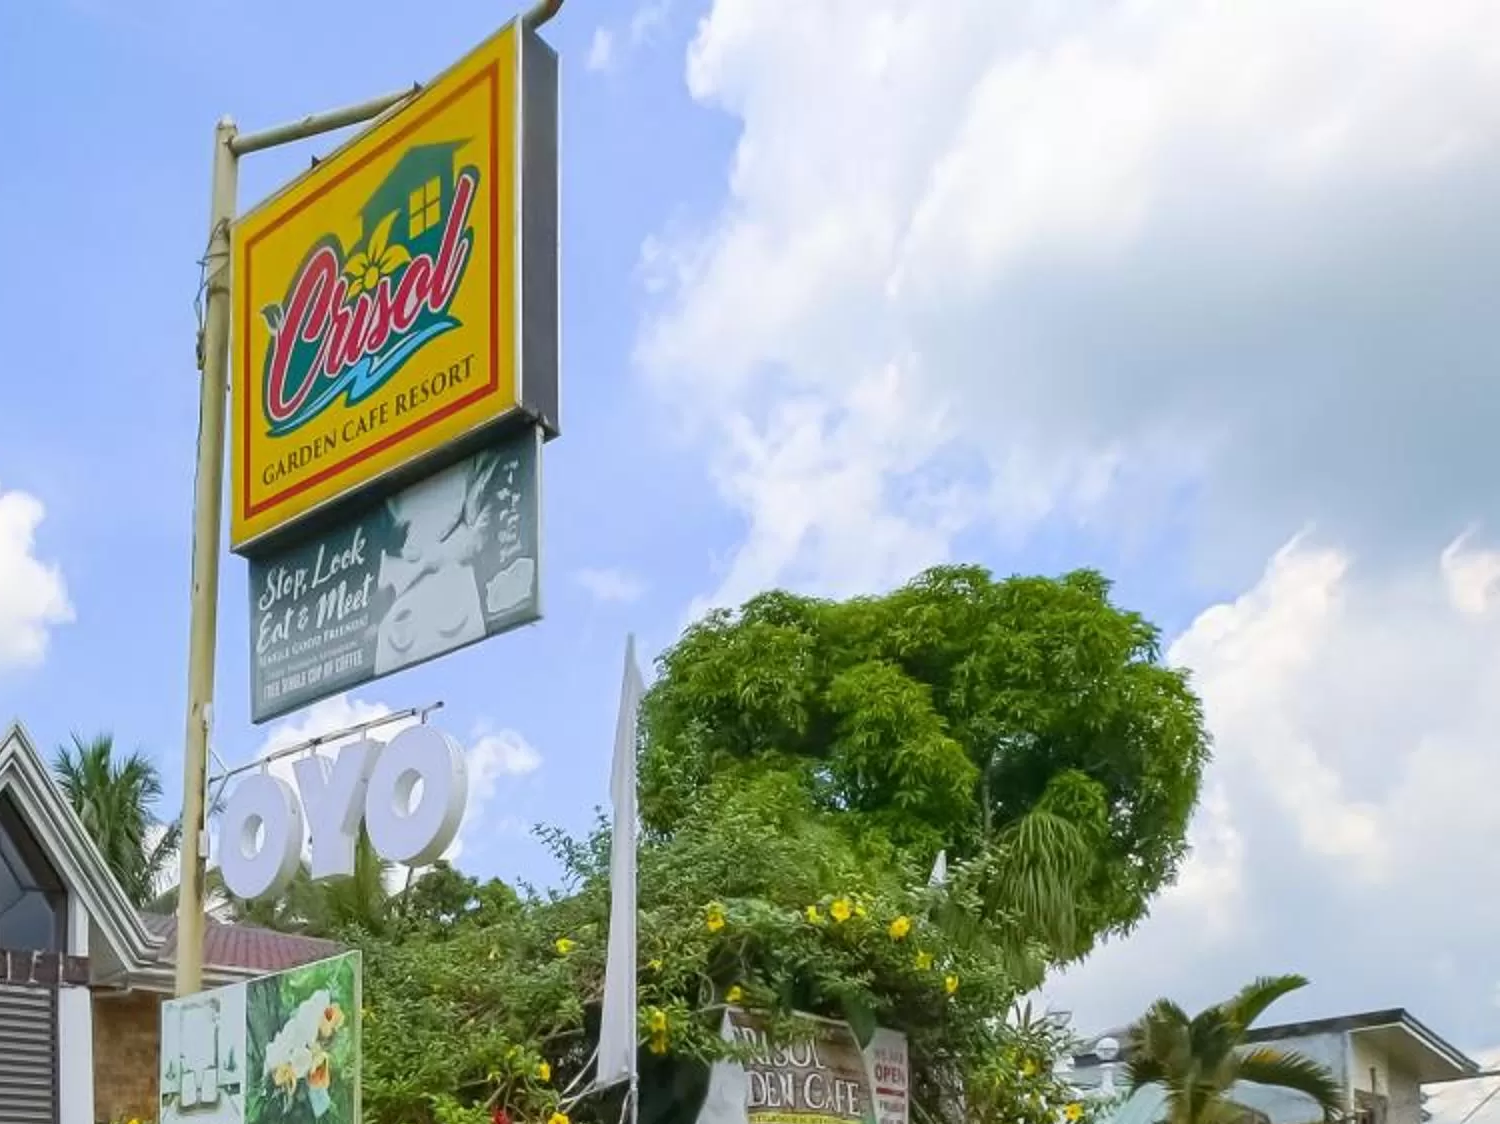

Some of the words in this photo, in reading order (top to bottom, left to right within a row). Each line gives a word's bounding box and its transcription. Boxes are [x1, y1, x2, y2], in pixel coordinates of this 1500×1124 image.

[269, 172, 475, 419] Crisol
[262, 430, 337, 486] GARDEN
[341, 401, 388, 443] CAFE
[394, 354, 475, 416] RESORT
[311, 527, 366, 589] Look
[256, 608, 294, 653] Eat
[316, 573, 374, 629] Meet
[218, 724, 468, 900] OYO
[747, 1070, 794, 1107] DEN
[804, 1073, 860, 1116] CAFE
